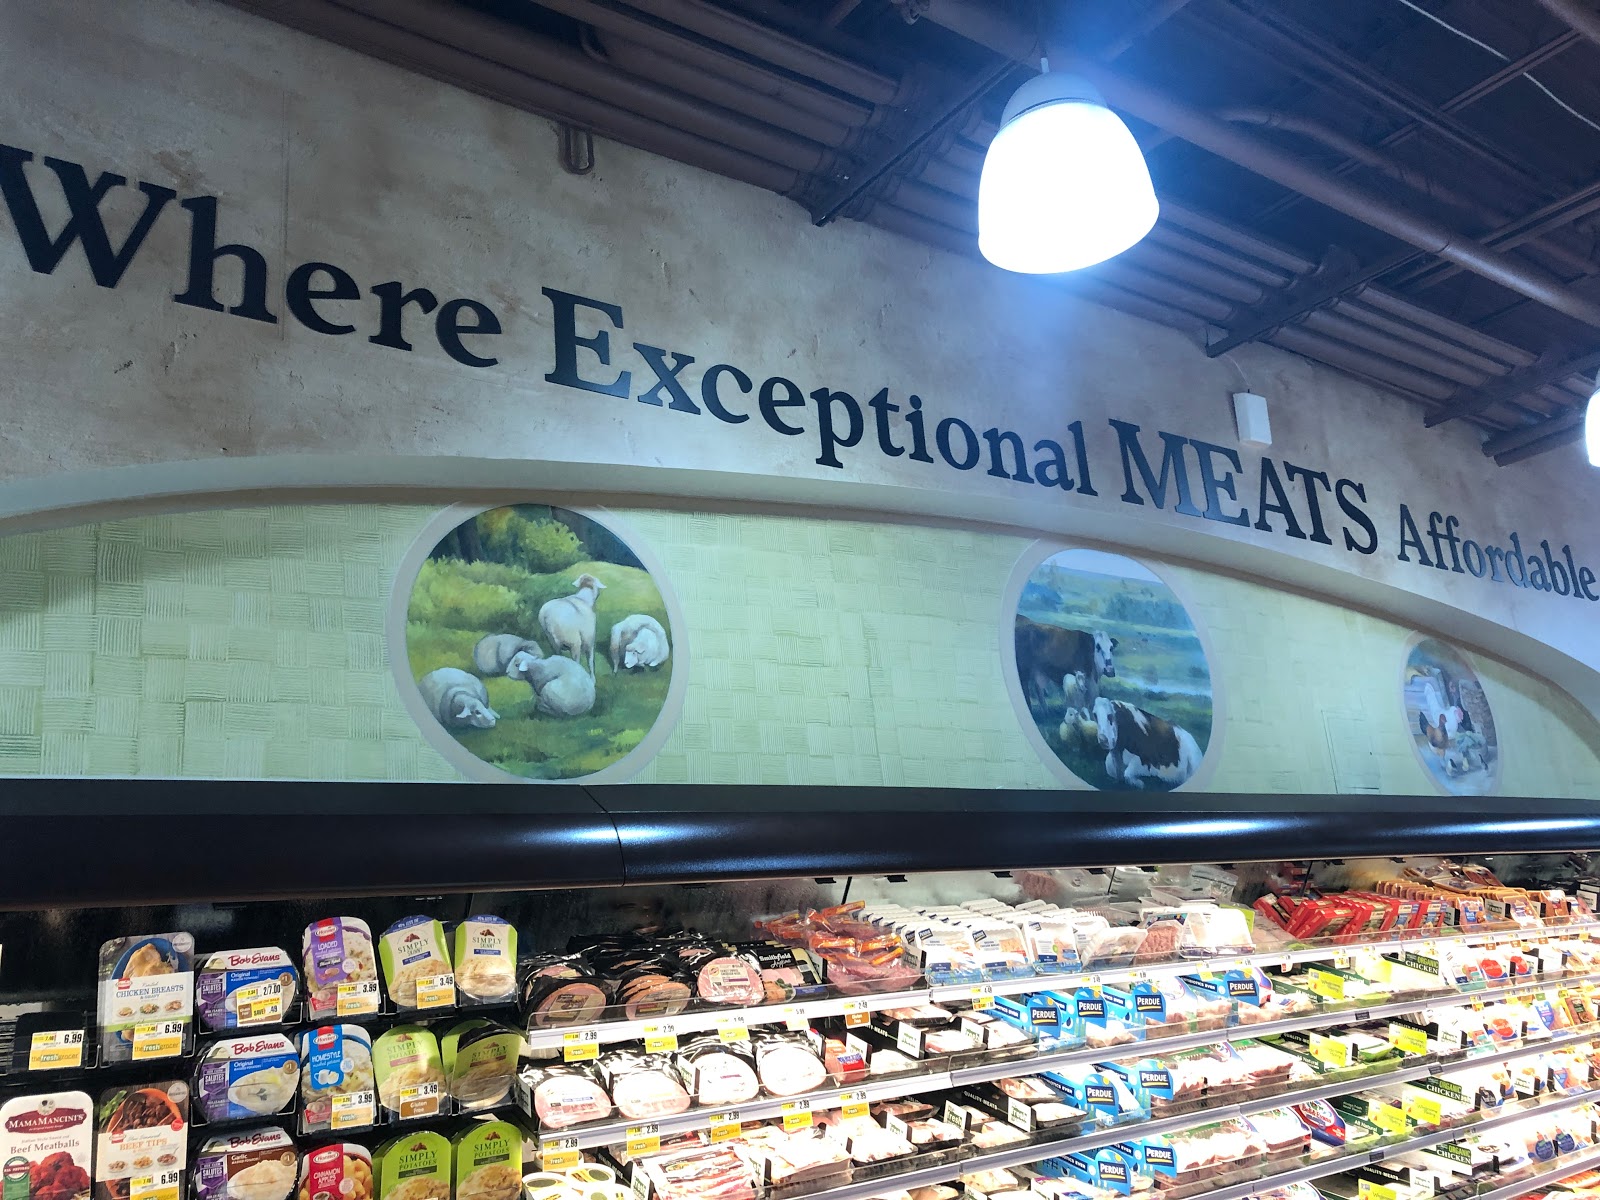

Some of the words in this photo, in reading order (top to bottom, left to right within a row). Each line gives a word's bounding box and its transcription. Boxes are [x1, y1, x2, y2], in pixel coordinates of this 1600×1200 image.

[0, 144, 502, 368] Where
[541, 286, 1099, 496] Exceptional
[1108, 418, 1379, 555] MEATS
[1397, 503, 1600, 602] Affordable
[318, 941, 338, 950] LOADED
[398, 938, 429, 954] SIMPLY
[228, 955, 251, 966] Bob
[251, 953, 280, 964] Evans
[759, 953, 791, 962] Smithfield
[1406, 960, 1438, 974] CHICKEN
[440, 976, 453, 986] 3.49
[116, 988, 149, 998] CHICKEN
[152, 984, 184, 994] BREASTS
[202, 984, 221, 992] SALUTES
[362, 984, 377, 993] 3.99
[1079, 1002, 1102, 1011] PERDUE
[1137, 997, 1160, 1006] PERDUE
[1032, 1009, 1056, 1019] PERDUE
[165, 1023, 182, 1034] 6.99
[64, 1033, 82, 1044] 6.99
[585, 1032, 597, 1040] 2.99
[232, 1043, 254, 1055] Bob
[255, 1041, 285, 1052] Evans
[312, 1051, 341, 1062] HOMESTYLE
[205, 1074, 224, 1083] SALUTES
[1141, 1073, 1167, 1082] PERDUE
[424, 1084, 437, 1095] 3.49
[1439, 1080, 1462, 1092] ORGANIC
[1087, 1088, 1112, 1098] PERDUE
[1426, 1084, 1462, 1100] CHICKEN
[358, 1094, 372, 1104] 3.99
[119, 1141, 145, 1150] BEEF
[146, 1138, 167, 1147] TIPS
[227, 1136, 251, 1148] Bob
[251, 1133, 282, 1145] Evans
[474, 1138, 510, 1152] SIMPLY
[11, 1145, 31, 1154] Beef
[34, 1139, 80, 1151] Meatballs
[1449, 1144, 1471, 1156] ORGANIC
[399, 1150, 438, 1164] SIMPLY
[474, 1147, 510, 1158] POTATOES
[1146, 1148, 1172, 1159] PERDUE
[1436, 1149, 1471, 1164] CHICKEN
[399, 1159, 437, 1170] POTATOES
[1100, 1163, 1125, 1175] PERDUE
[203, 1168, 222, 1176] SALUTES
[313, 1168, 340, 1179] CINNAMON
[161, 1172, 178, 1184] 6.99
